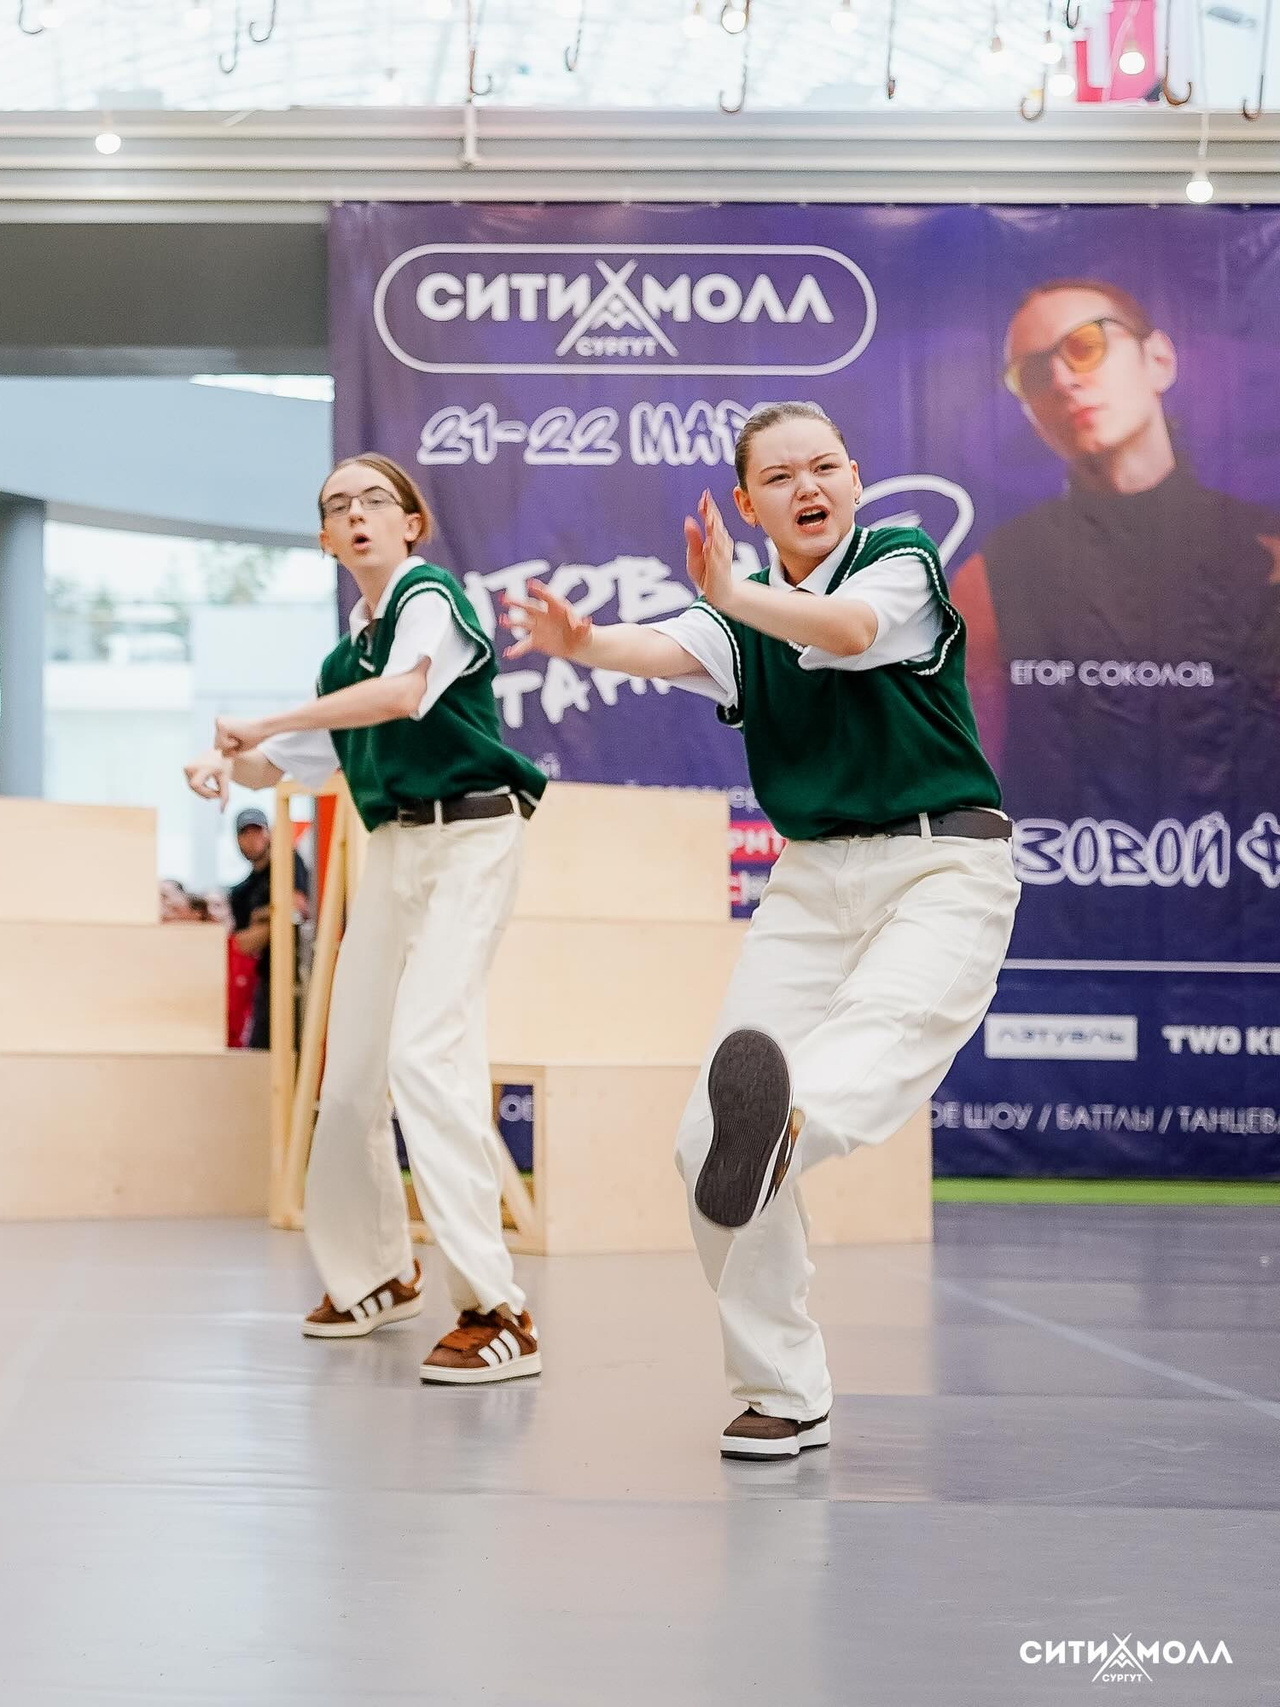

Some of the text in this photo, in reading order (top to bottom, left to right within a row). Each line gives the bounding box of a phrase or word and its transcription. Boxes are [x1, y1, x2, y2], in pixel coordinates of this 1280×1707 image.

[416, 272, 835, 324] СИТИ МОЛЛ
[575, 335, 658, 358] СУРГУТ
[417, 403, 620, 466] 21-22
[1010, 659, 1215, 687] ЕГОР СОКОЛОВ
[1161, 1024, 1242, 1056] TWO
[963, 1101, 1033, 1130] ШОУ
[1176, 1104, 1280, 1137] ТАНЦЕВ
